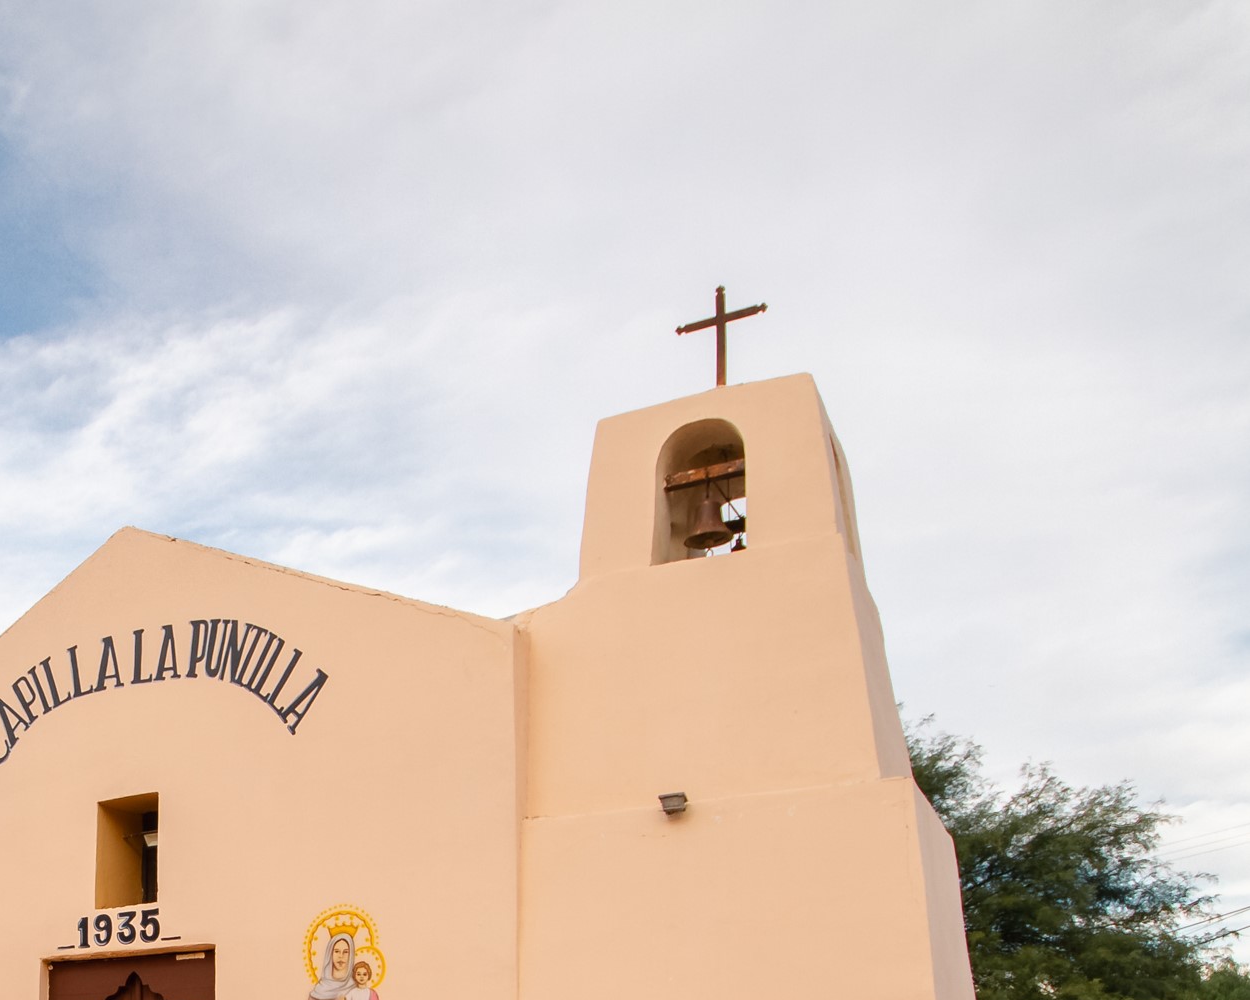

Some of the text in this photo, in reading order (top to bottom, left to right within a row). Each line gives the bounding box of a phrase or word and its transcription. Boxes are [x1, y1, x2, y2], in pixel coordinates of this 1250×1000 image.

[130, 624, 181, 685] LA
[186, 618, 329, 735] PUNTILLA
[77, 908, 160, 948] 1935
